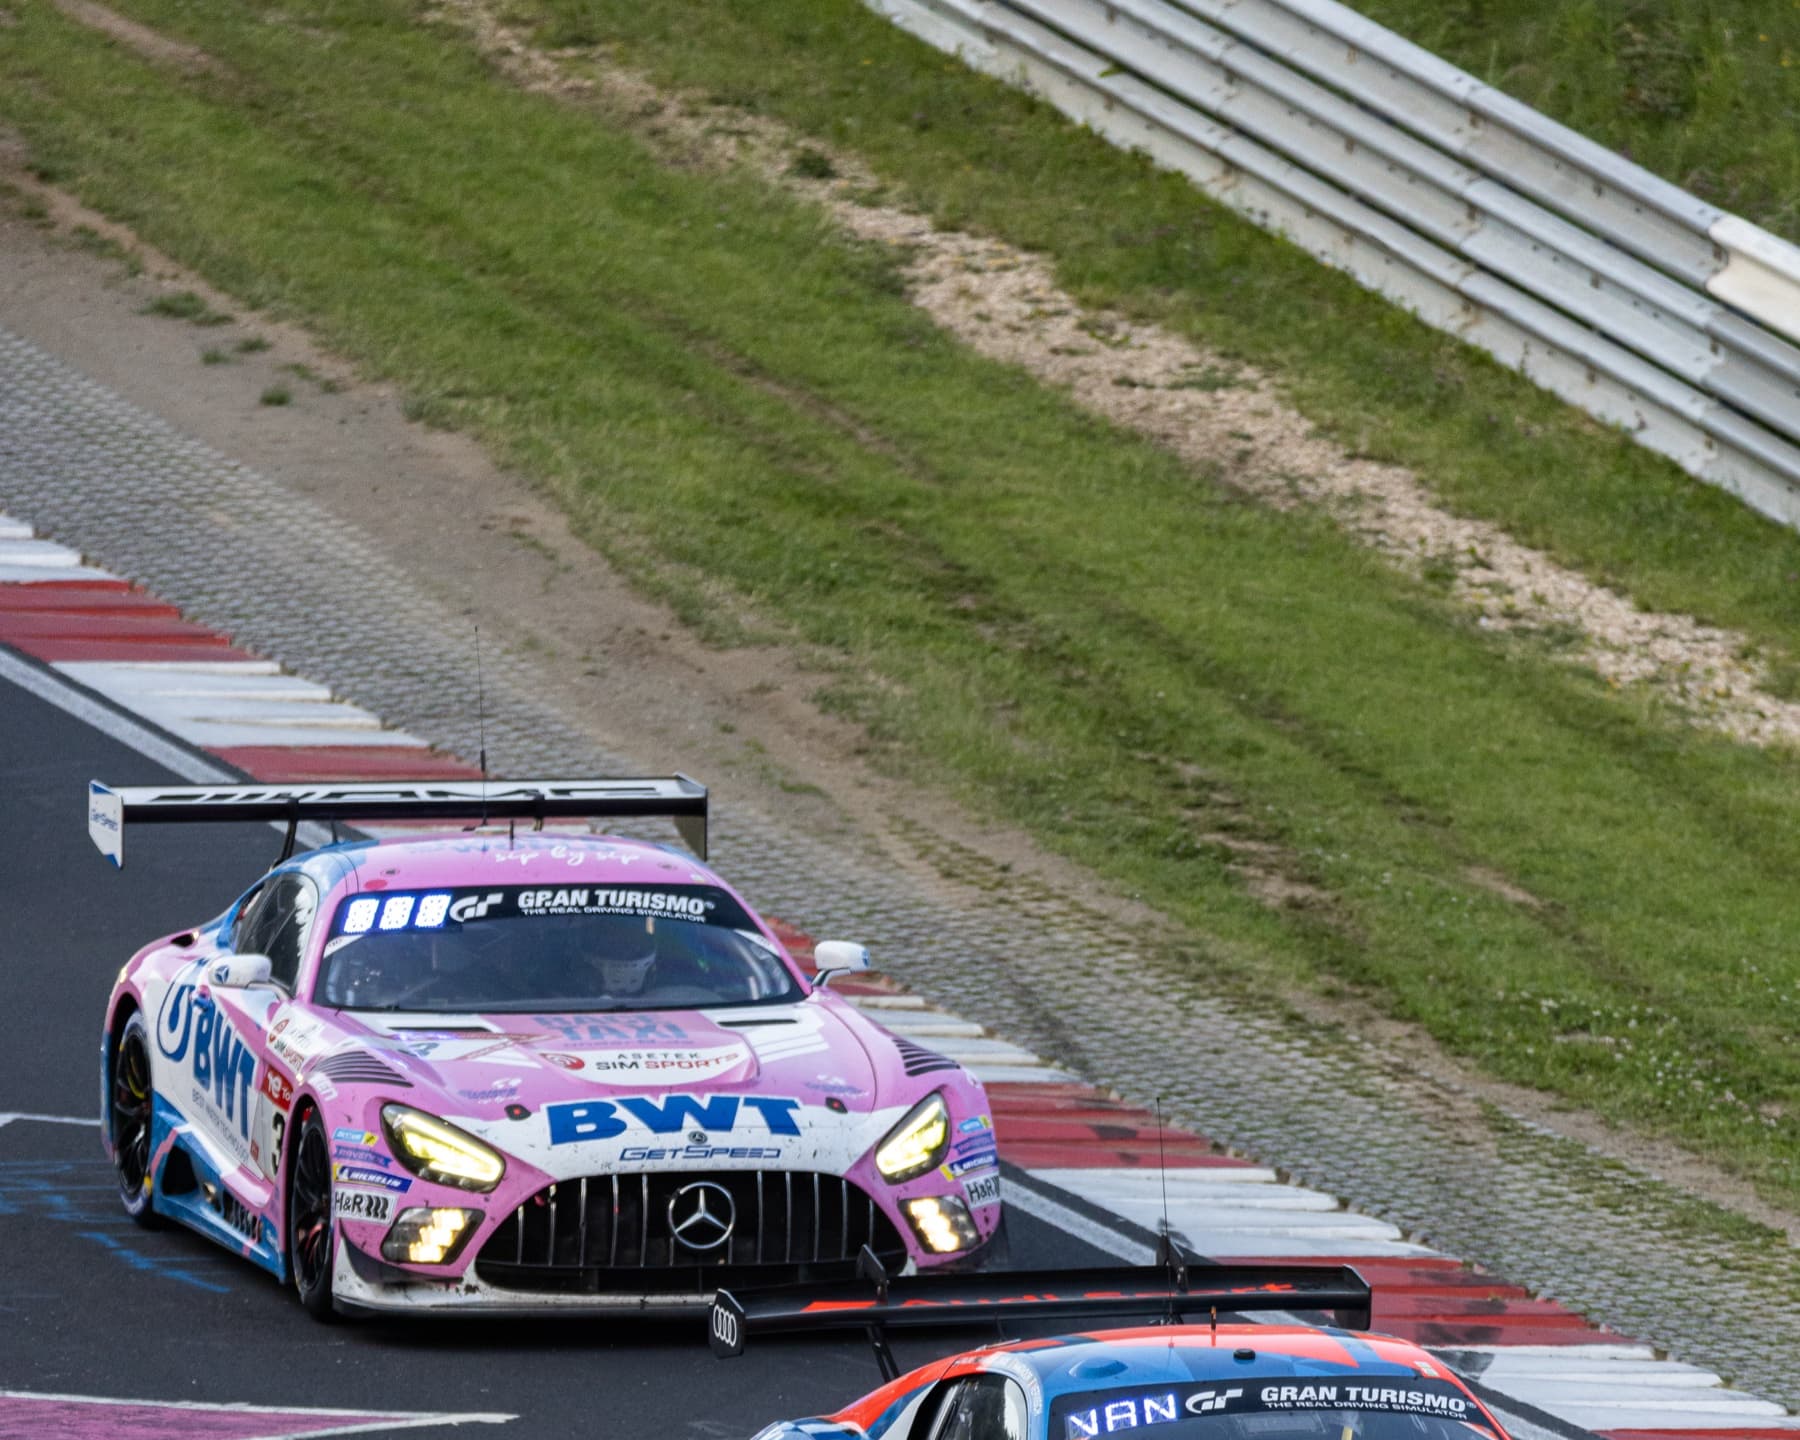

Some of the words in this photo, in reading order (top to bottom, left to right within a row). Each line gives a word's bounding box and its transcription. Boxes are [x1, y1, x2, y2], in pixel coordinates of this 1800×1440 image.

[518, 889, 590, 908] GRAN
[522, 908, 548, 916] THE
[596, 1060, 640, 1071] SIM
[644, 1052, 739, 1070] SPORTS
[617, 1052, 700, 1060] ASETEK
[193, 997, 257, 1143] BWT
[546, 1095, 801, 1146] BWT
[272, 1111, 286, 1176] 3
[1261, 1386, 1338, 1402] GRAN
[1070, 1393, 1177, 1436] VAN
[1264, 1401, 1294, 1409] THE
[1296, 1401, 1332, 1409] REAL
[1334, 1401, 1390, 1410] DRIVING
[1391, 1403, 1468, 1421] SIMULATOR
